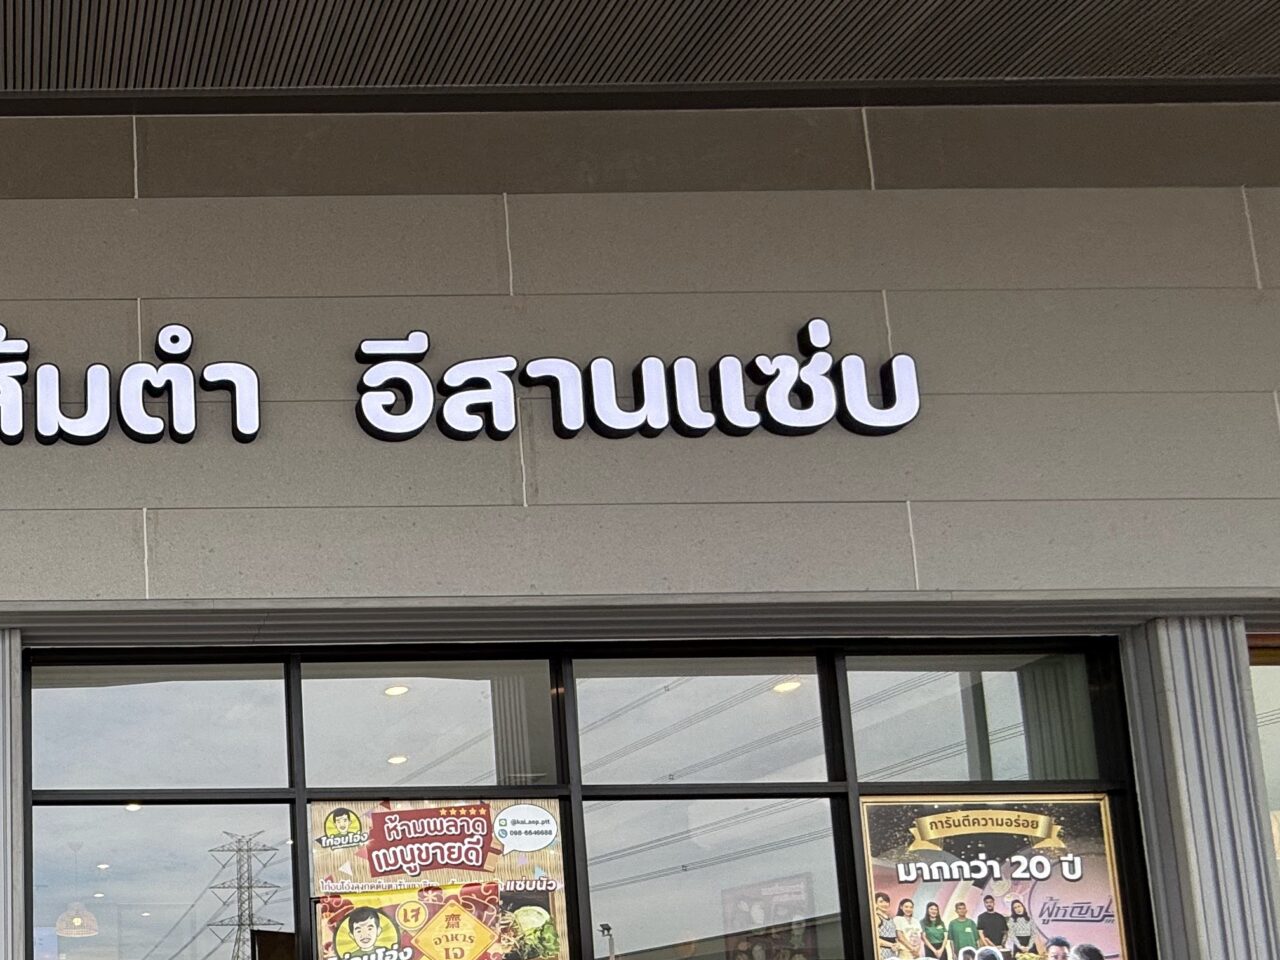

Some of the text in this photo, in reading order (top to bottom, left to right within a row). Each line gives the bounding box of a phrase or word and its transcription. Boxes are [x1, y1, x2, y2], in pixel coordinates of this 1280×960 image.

[357, 317, 921, 436] อีสานแซ่บ
[384, 815, 489, 841] ห้ามพลาด
[928, 813, 1040, 832] การันตีความอร่อย
[320, 830, 369, 848] ไก่อบโอ่ง
[370, 840, 484, 877] เมนูขายดี
[896, 852, 1083, 883] มากกว่า 20 ปี
[505, 875, 557, 892] แซ่บนัว
[432, 933, 475, 946] อาหาร
[443, 946, 465, 960] เจ
